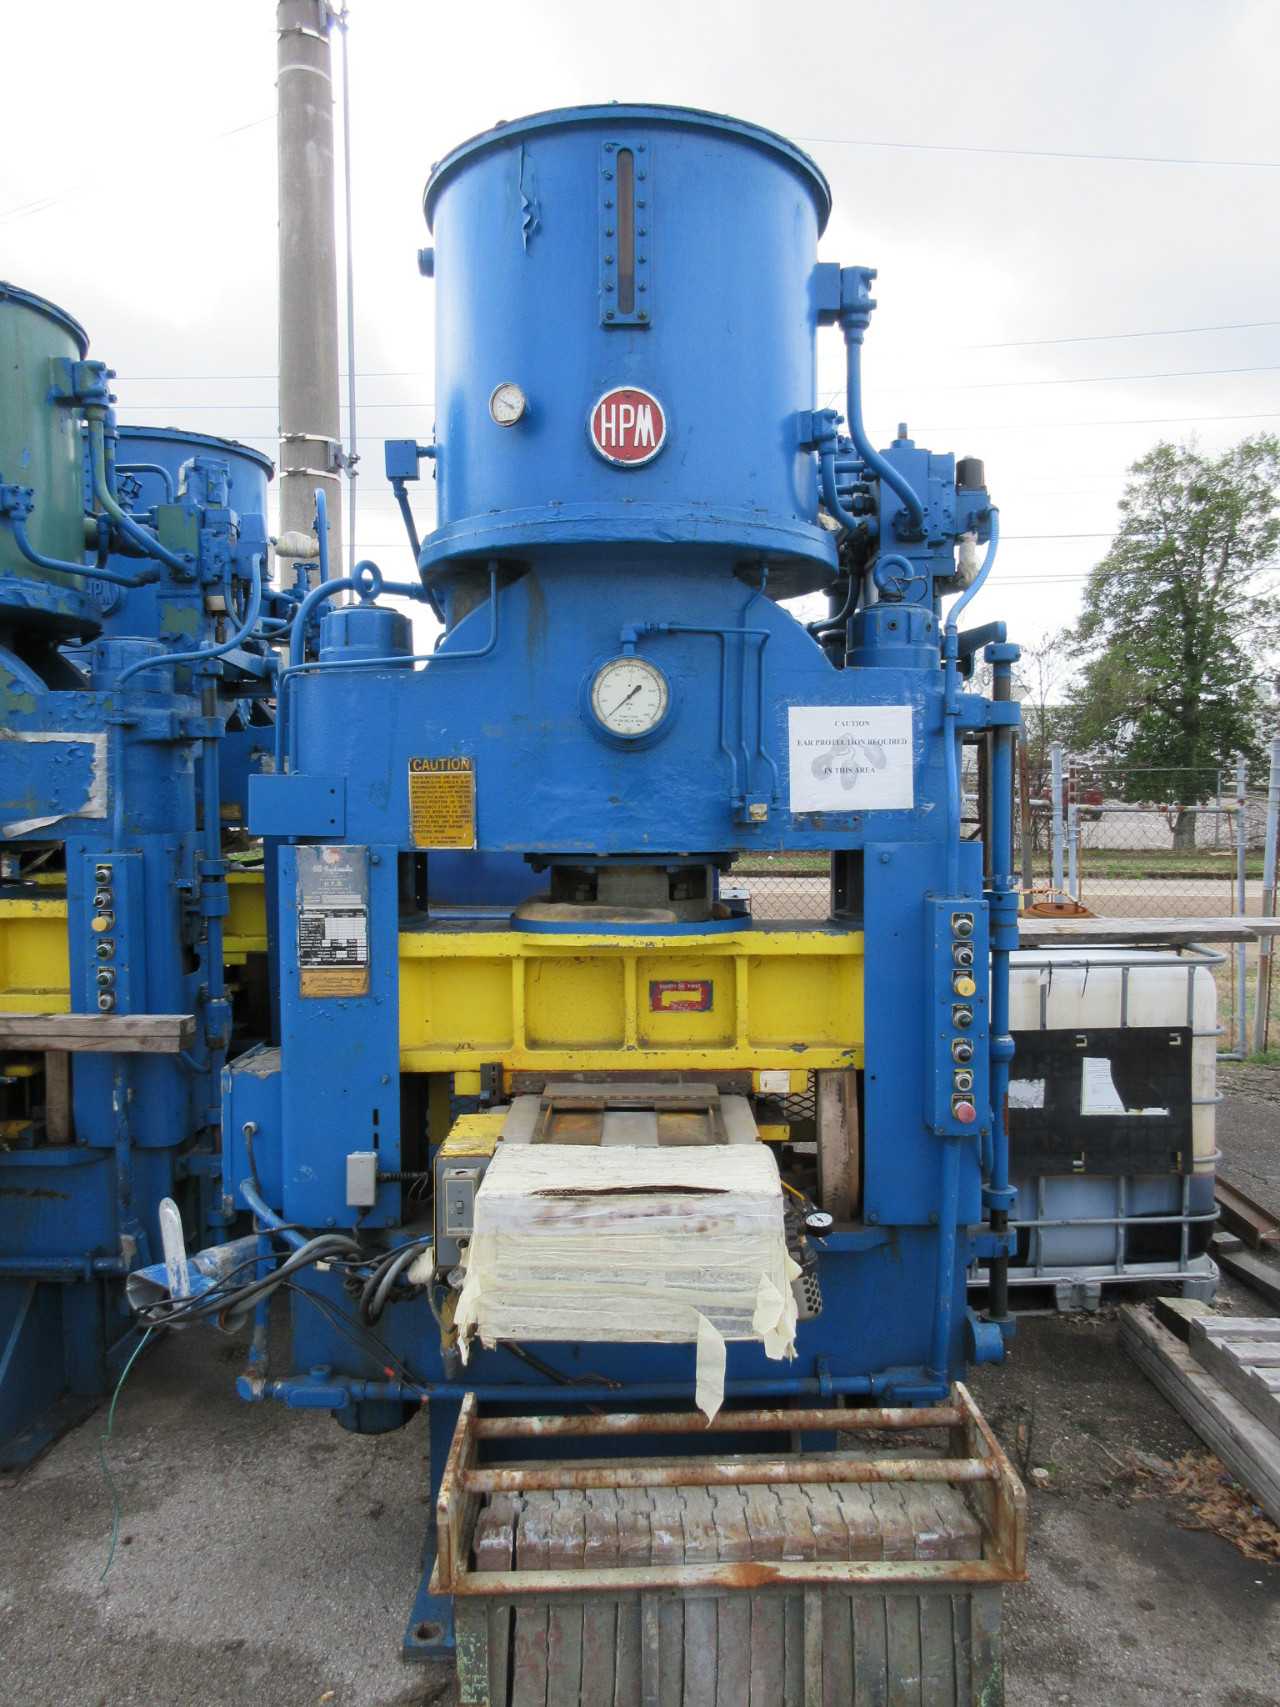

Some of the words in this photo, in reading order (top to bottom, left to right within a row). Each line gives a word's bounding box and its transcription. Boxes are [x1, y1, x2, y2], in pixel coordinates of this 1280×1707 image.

[601, 404, 656, 447] HPM
[815, 738, 866, 746] PROTECTION
[413, 757, 470, 771] CAUTION
[824, 767, 833, 775] IN
